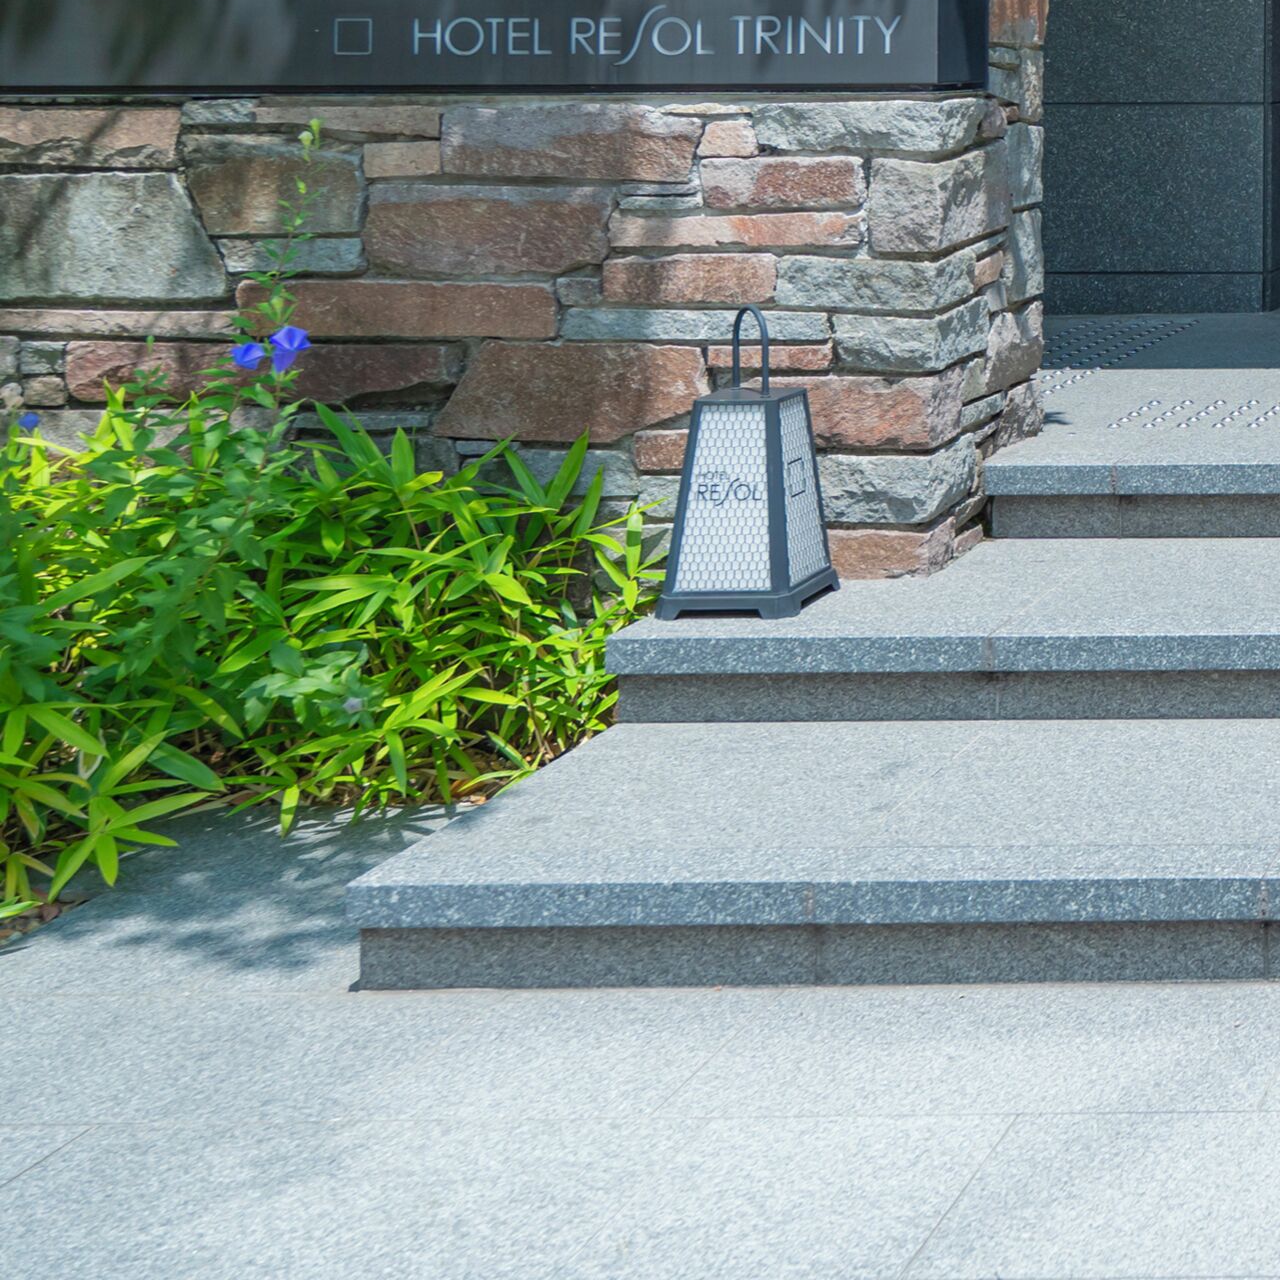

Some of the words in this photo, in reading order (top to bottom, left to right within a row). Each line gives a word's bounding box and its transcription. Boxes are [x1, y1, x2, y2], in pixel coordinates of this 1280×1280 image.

[413, 17, 552, 56] HOTEL
[570, 4, 715, 66] RESOL
[730, 15, 902, 55] TRINITY
[697, 477, 762, 506] RESOL
